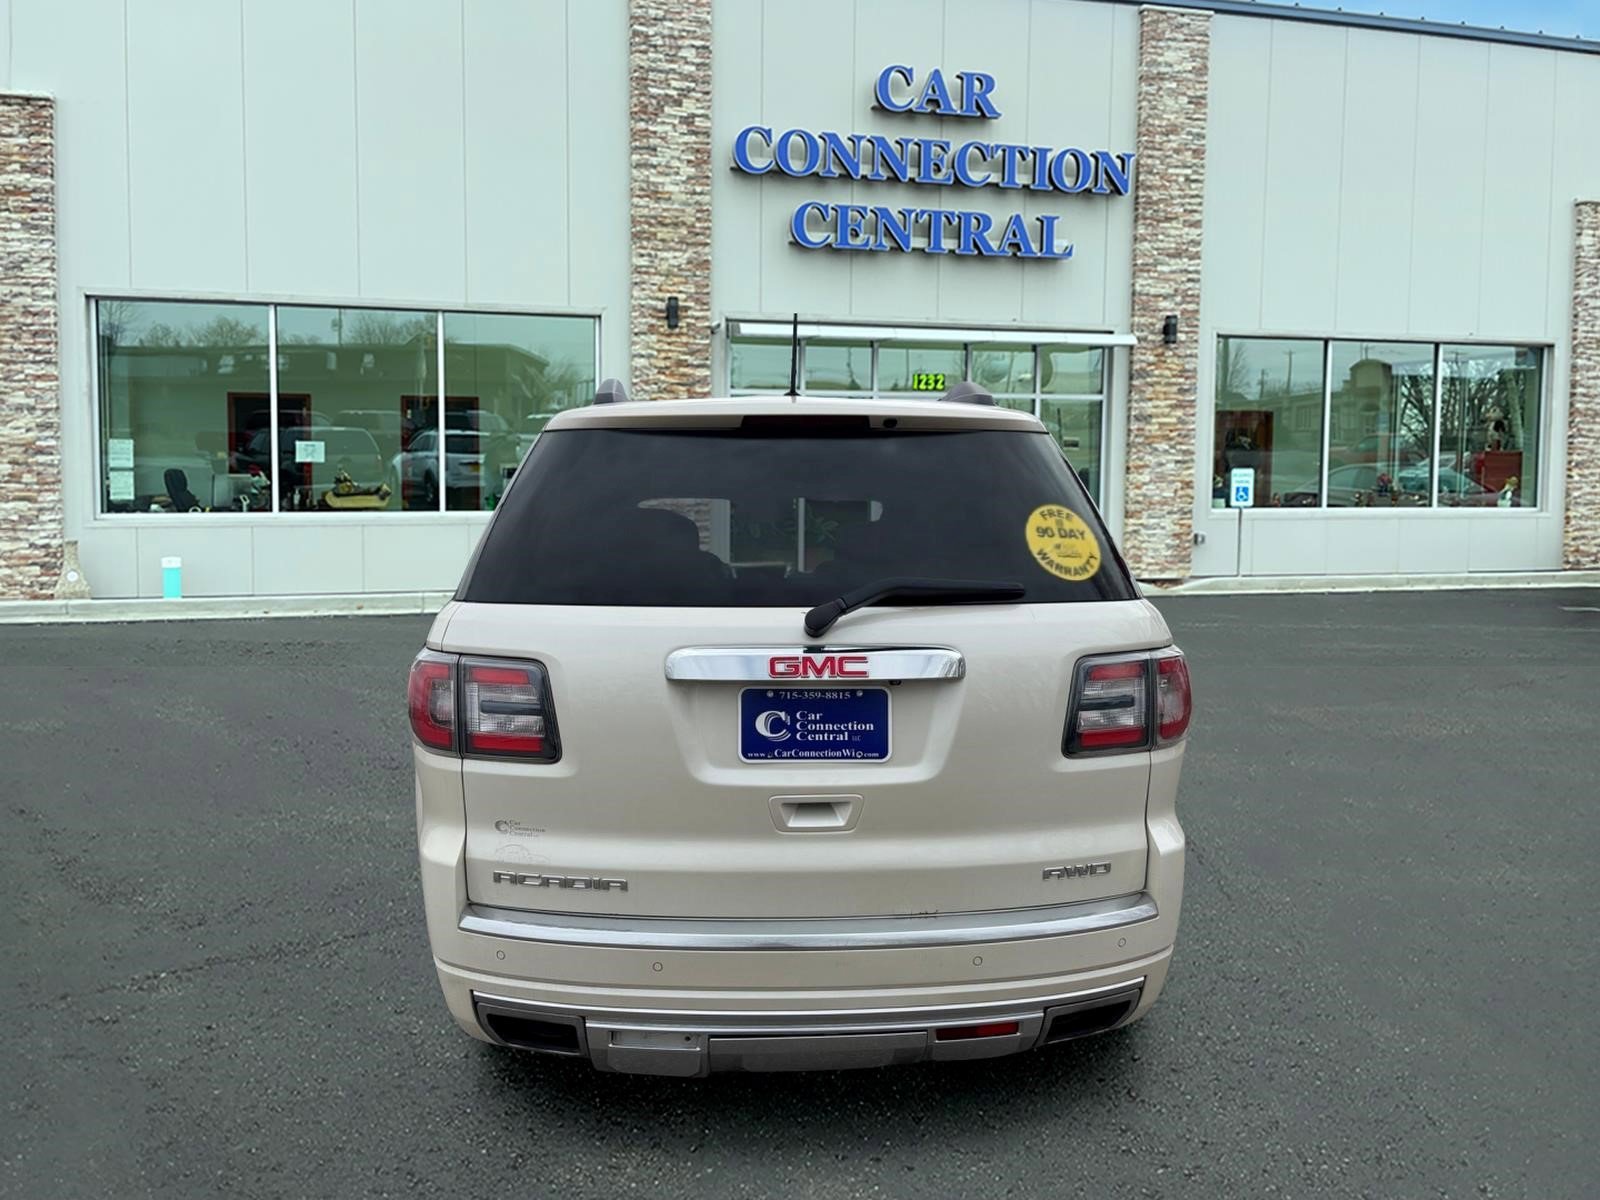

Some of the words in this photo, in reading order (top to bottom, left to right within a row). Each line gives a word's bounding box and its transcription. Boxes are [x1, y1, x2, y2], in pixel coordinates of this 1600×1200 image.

[874, 64, 1001, 119] CAR
[731, 125, 1135, 196] CONNECTION
[789, 201, 1074, 260] CENTRAL
[912, 373, 945, 390] 1232
[1039, 508, 1075, 521] FREE
[1036, 526, 1055, 538] 90
[1058, 528, 1086, 541] DAY
[1036, 548, 1098, 577] WARRANTY
[768, 655, 869, 679] GMC
[779, 691, 851, 700] 715-359-8815
[795, 710, 824, 721] Car
[795, 720, 875, 731] Connection
[795, 731, 849, 741] Central
[1042, 861, 1112, 881] AWD
[493, 870, 629, 892] ACADIA
